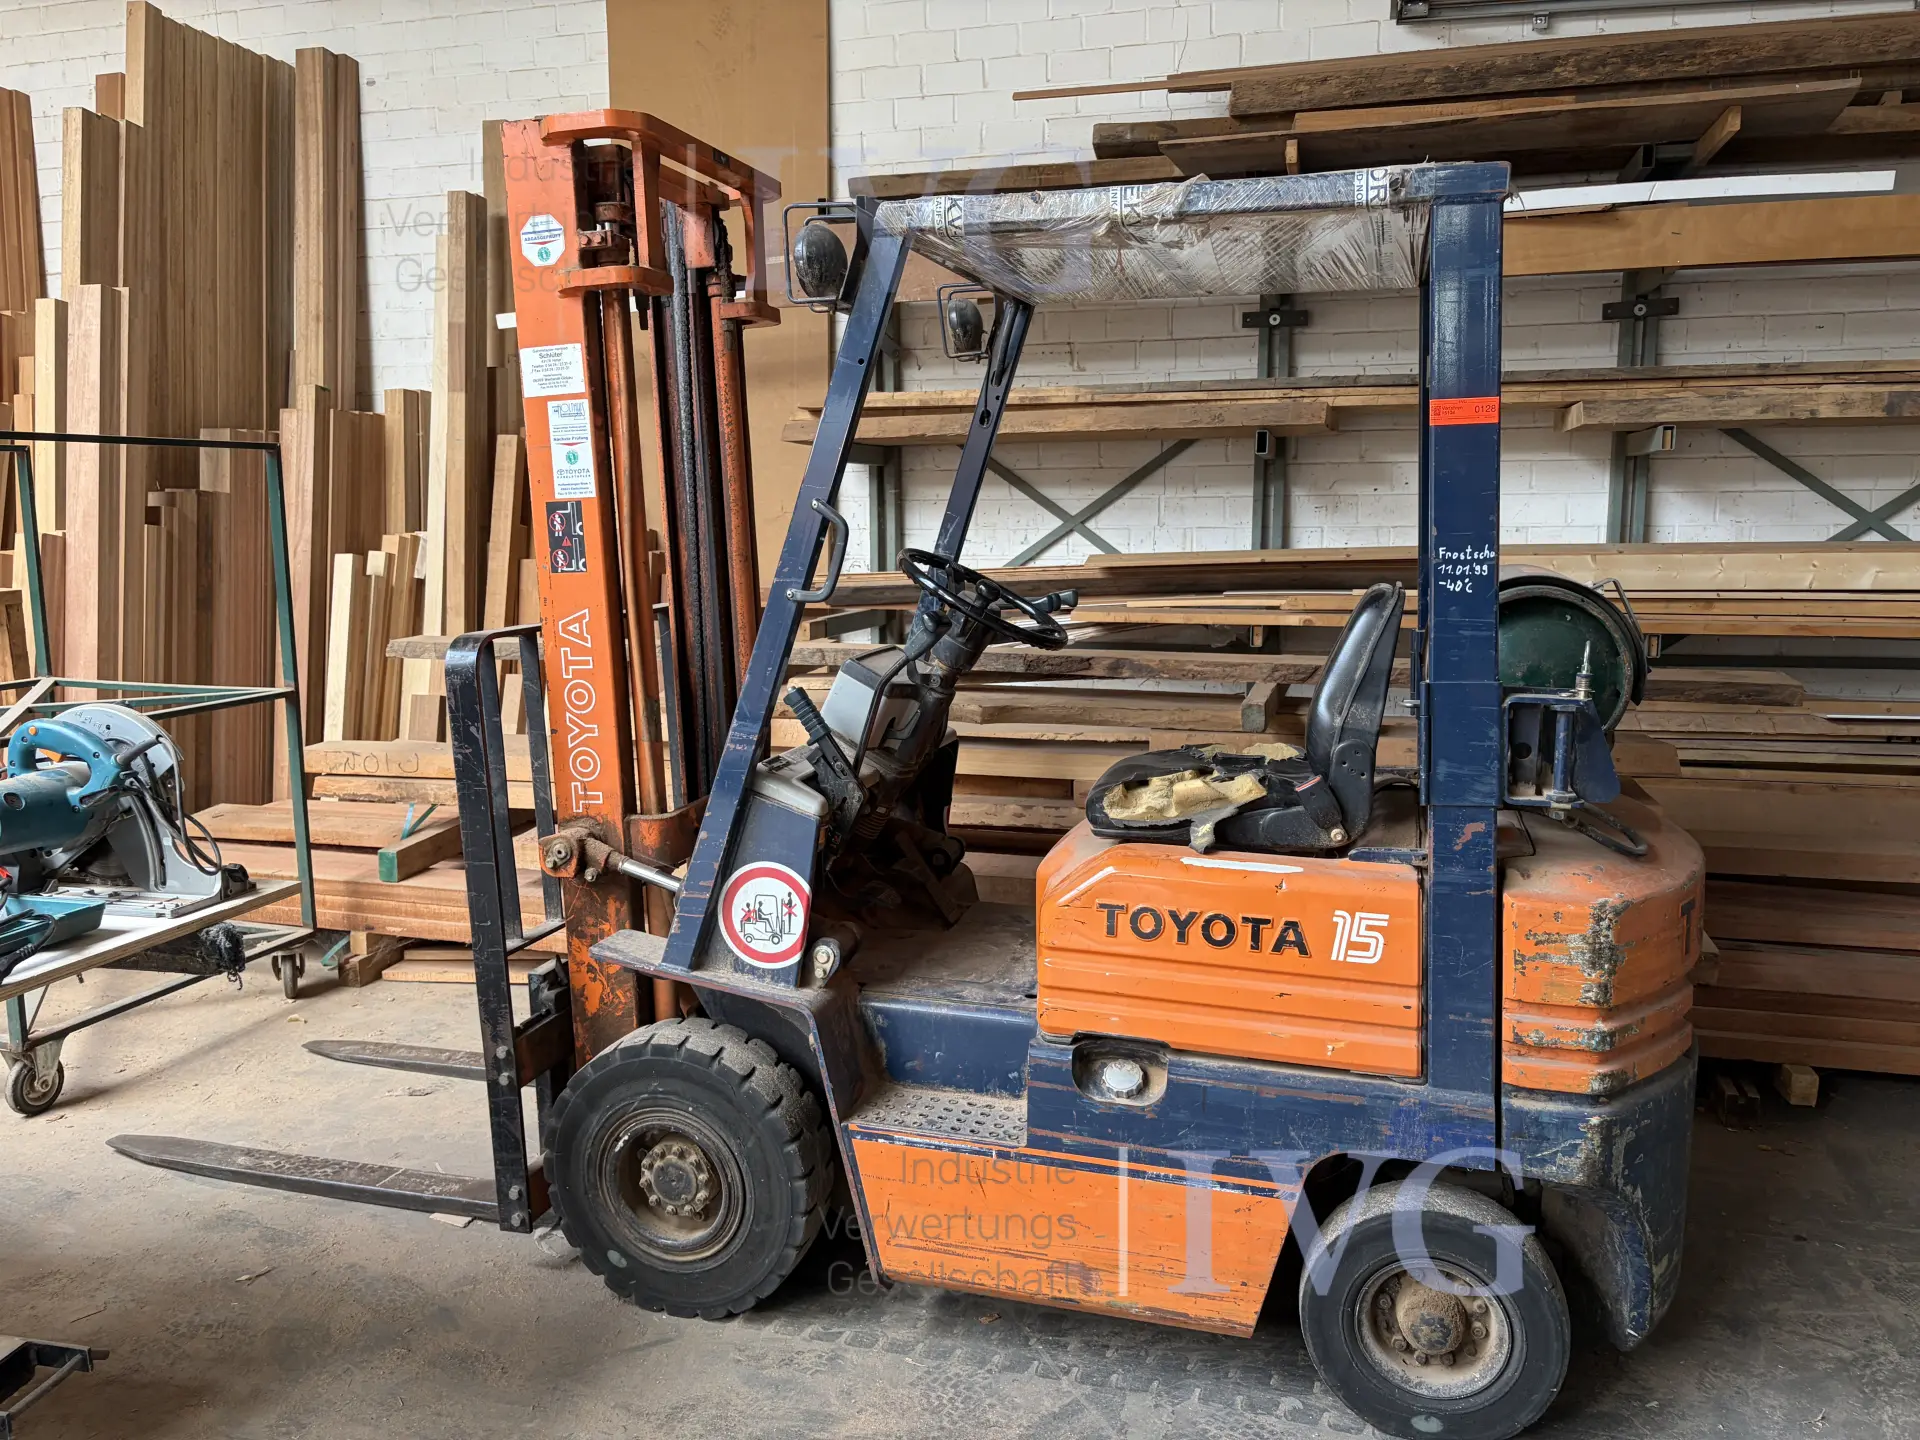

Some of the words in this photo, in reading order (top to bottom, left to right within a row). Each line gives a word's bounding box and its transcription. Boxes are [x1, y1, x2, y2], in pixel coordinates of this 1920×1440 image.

[1474, 404, 1497, 414] 0128
[558, 608, 603, 813] TOYOTA
[1095, 898, 1313, 959] TOYOTA
[1331, 909, 1390, 965] 15
